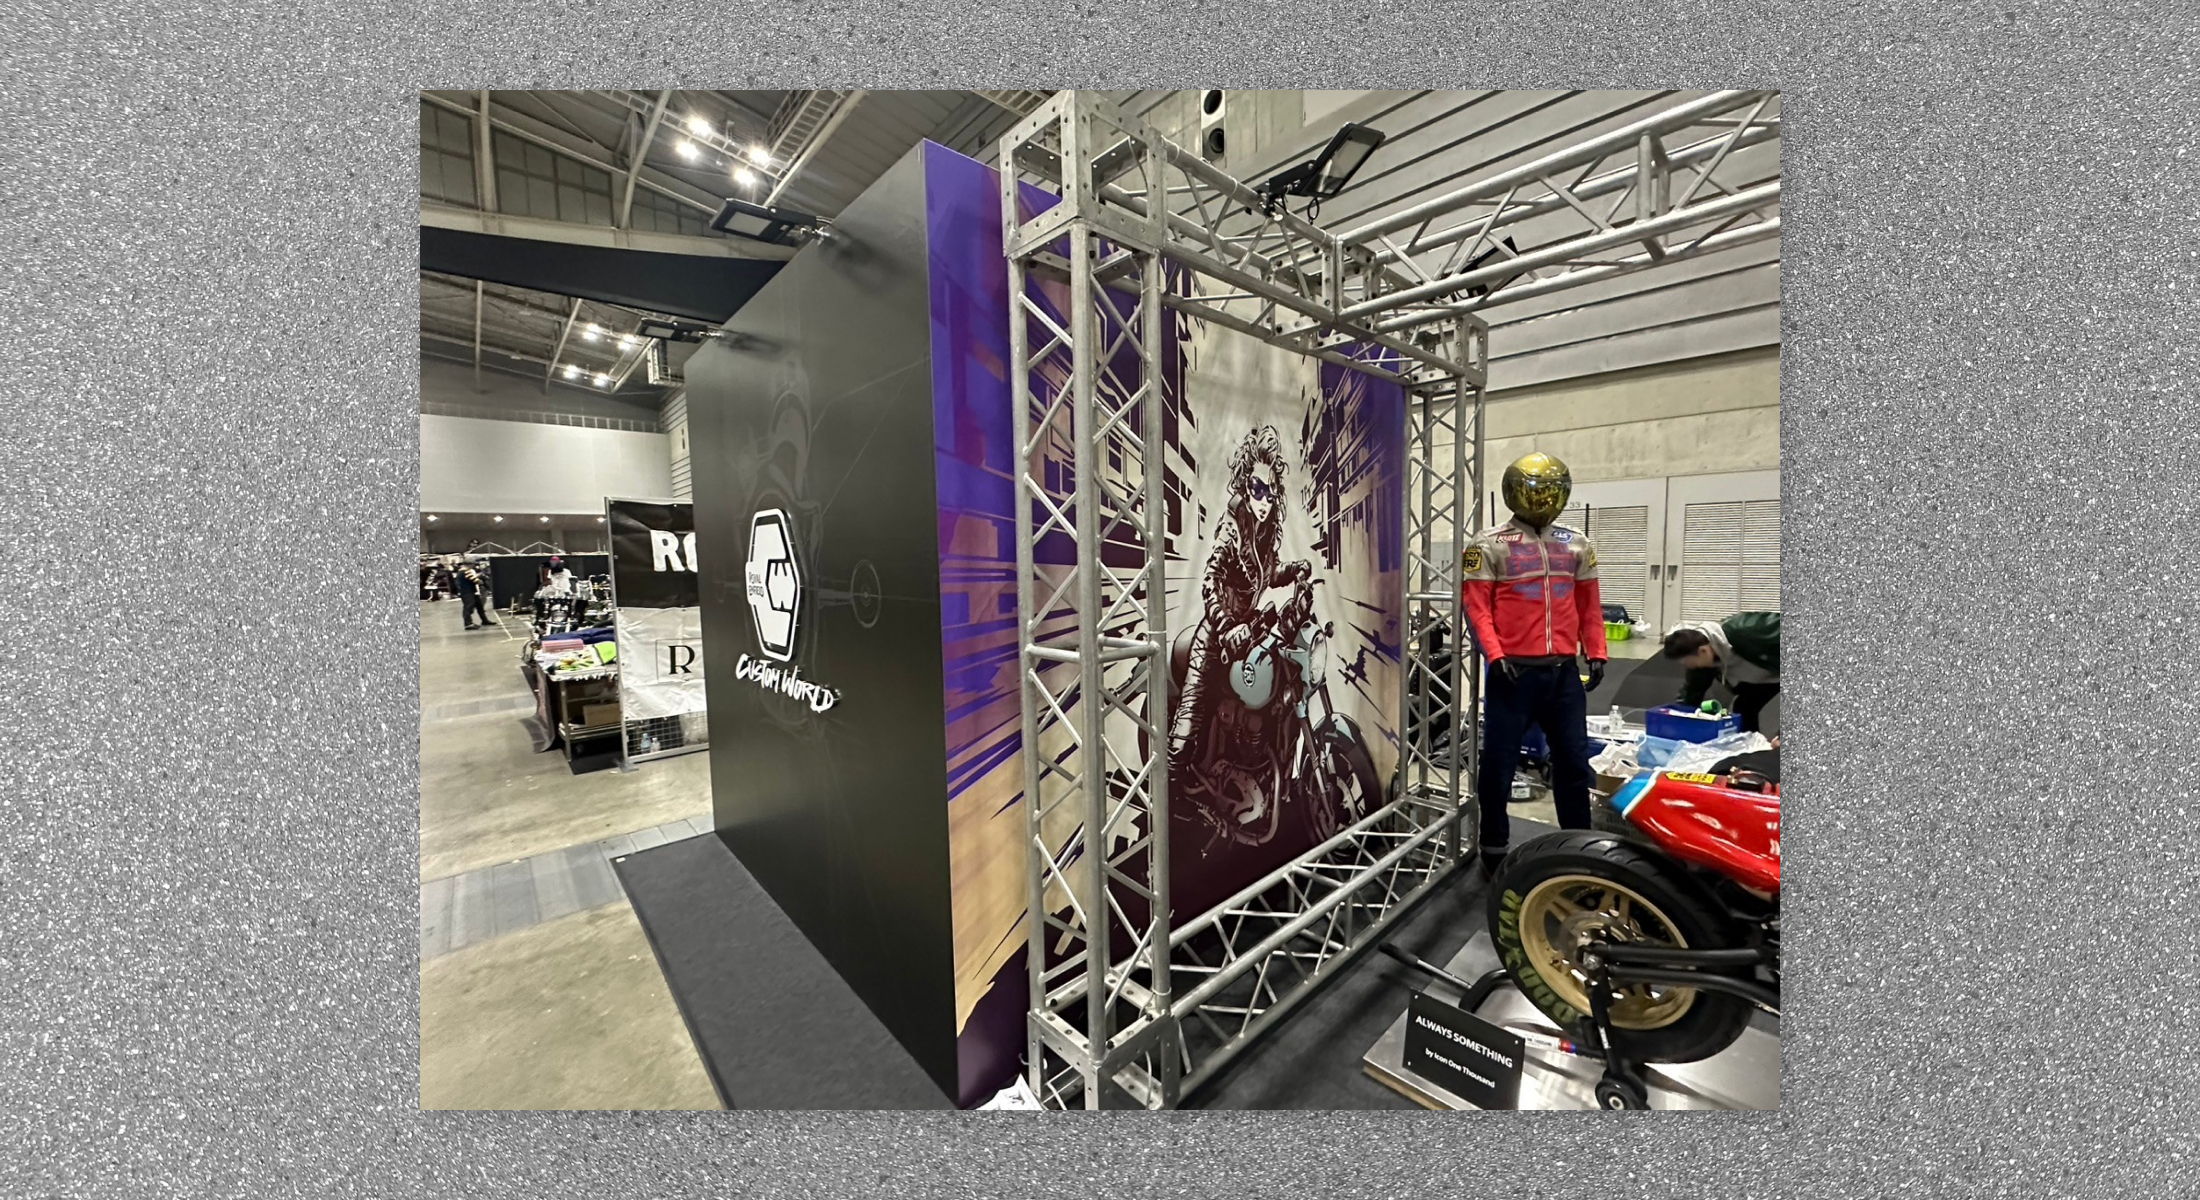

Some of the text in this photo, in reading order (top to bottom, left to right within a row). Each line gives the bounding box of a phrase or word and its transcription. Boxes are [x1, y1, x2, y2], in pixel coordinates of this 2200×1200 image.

[735, 653, 834, 714] CUSTOM WORLD
[1415, 1015, 1513, 1068] ALWAYS SOMETHING
[1425, 1047, 1433, 1058] by
[1449, 1059, 1462, 1072] One
[1463, 1066, 1495, 1088] Thousand
